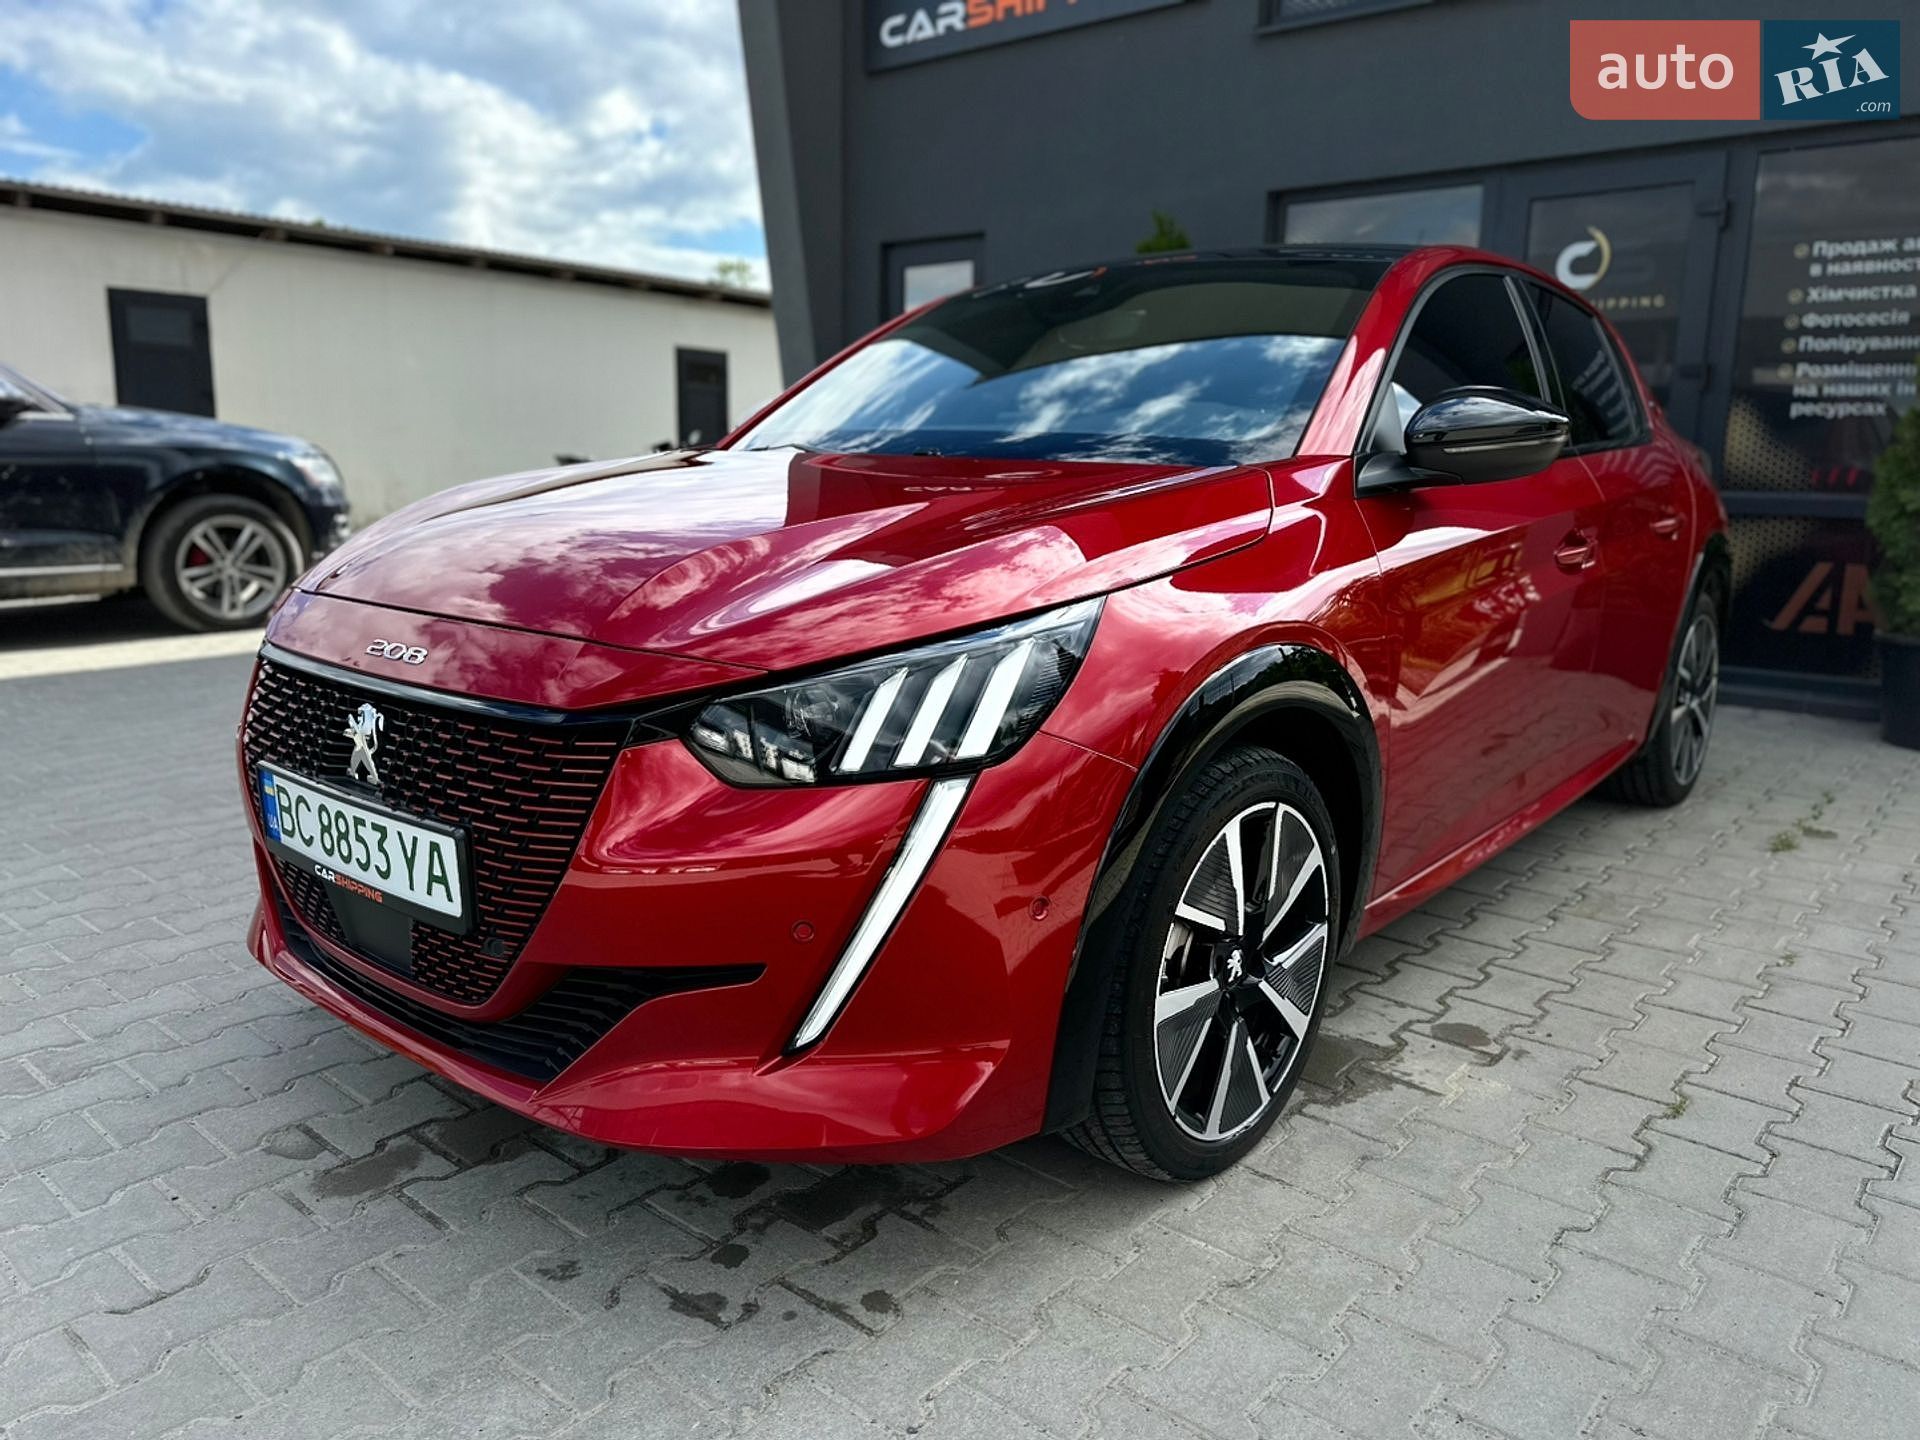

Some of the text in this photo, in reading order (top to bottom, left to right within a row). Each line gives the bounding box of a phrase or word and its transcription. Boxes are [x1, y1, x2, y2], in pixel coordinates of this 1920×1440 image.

[1812, 239, 1898, 259] Продаж
[1806, 284, 1917, 304] Хімчистка
[1801, 308, 1910, 329] Фотосесія
[1789, 401, 1887, 420] ресурсах
[365, 639, 428, 664] 208
[314, 864, 383, 903] CARSHIPPING
